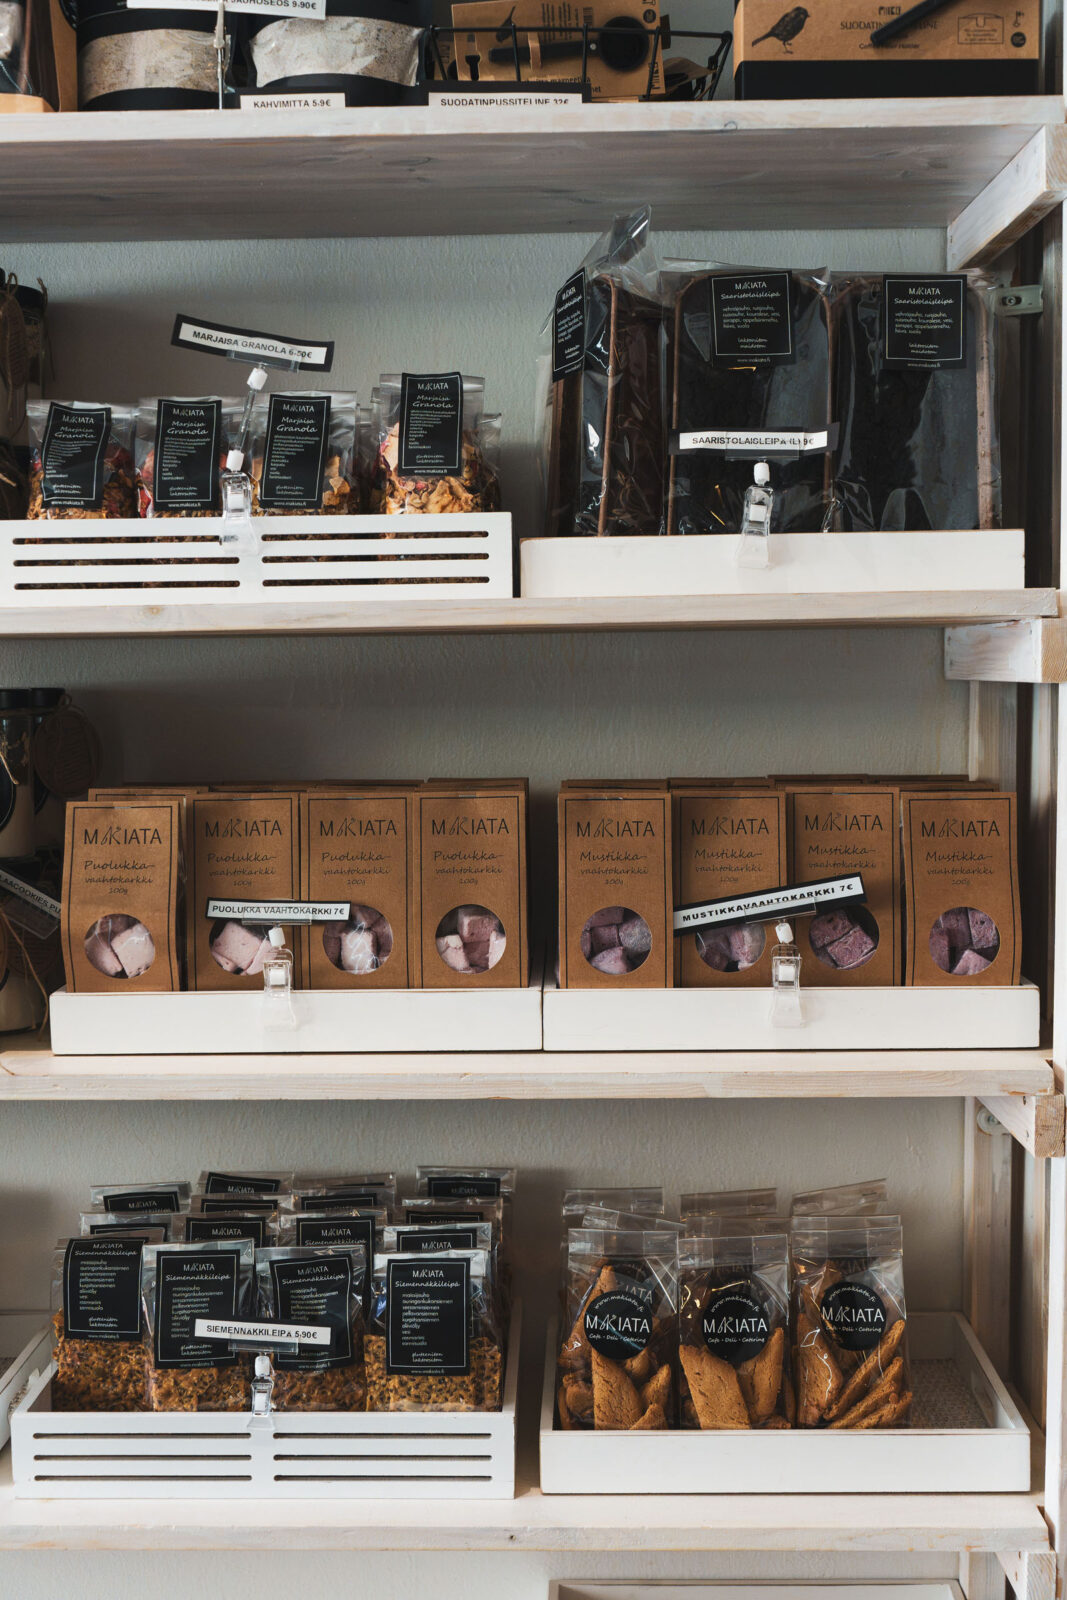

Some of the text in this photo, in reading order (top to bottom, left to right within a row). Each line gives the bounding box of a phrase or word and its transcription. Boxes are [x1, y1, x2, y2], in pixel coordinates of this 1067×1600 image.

[292, 1, 317, 10] 9.90€
[253, 99, 332, 108] KAHVIMITTA 5.9€
[192, 330, 239, 346] MARJAISA
[241, 341, 287, 355] GRANOLA
[695, 863, 763, 873] vaahtokarkki
[808, 860, 877, 869] vaahtokarkki
[208, 867, 276, 877] vaahtokarkki
[323, 867, 392, 877] vaahtokarkki
[435, 865, 503, 875] vaahtokarkki
[580, 866, 649, 875] vaahtokarkki
[927, 867, 994, 876] vaahtokarkki
[85, 875, 153, 885] vaahtokarkki
[682, 884, 854, 922] MUSTIKKAVAAHTOKARKKI 7€
[212, 905, 262, 914] PUOLUKKA
[263, 906, 332, 915] VAAHTOKARKKI
[294, 1331, 318, 1339] 5.90€
